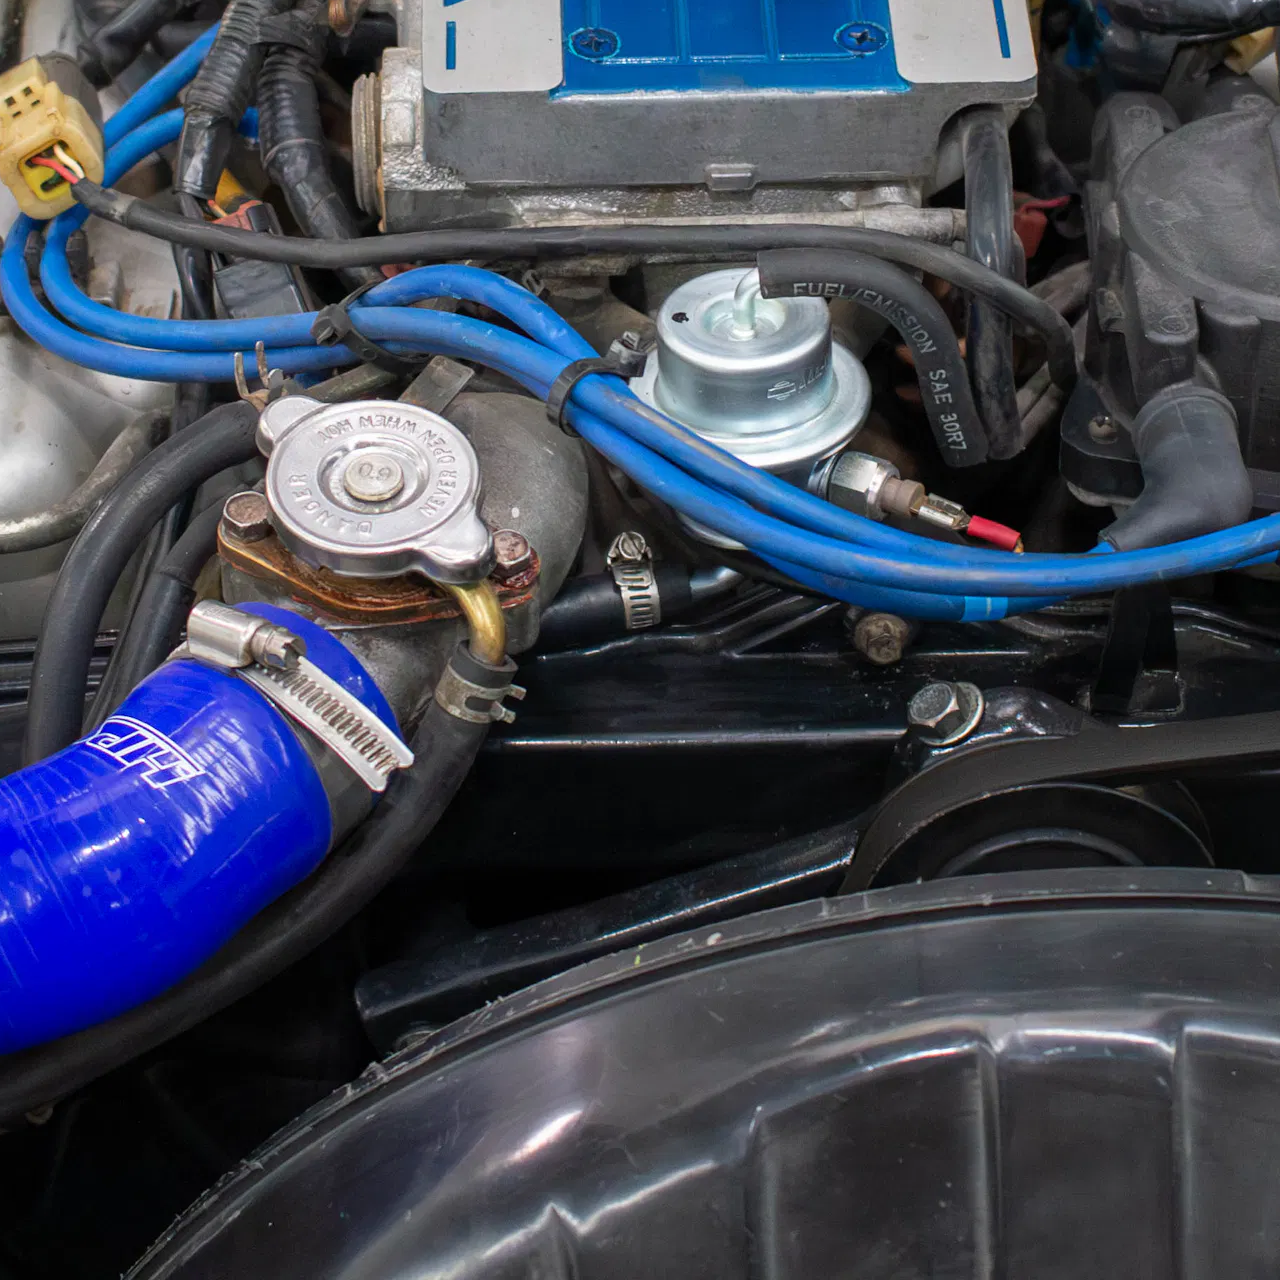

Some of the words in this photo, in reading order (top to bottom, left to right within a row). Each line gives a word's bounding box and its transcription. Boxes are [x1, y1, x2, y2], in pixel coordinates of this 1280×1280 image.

[929, 369, 953, 405] SAE
[316, 418, 354, 444] HOT
[359, 414, 418, 434] WHEN
[419, 429, 457, 465] OPEN
[288, 473, 373, 536] DANGER
[420, 469, 458, 517] NEVER
